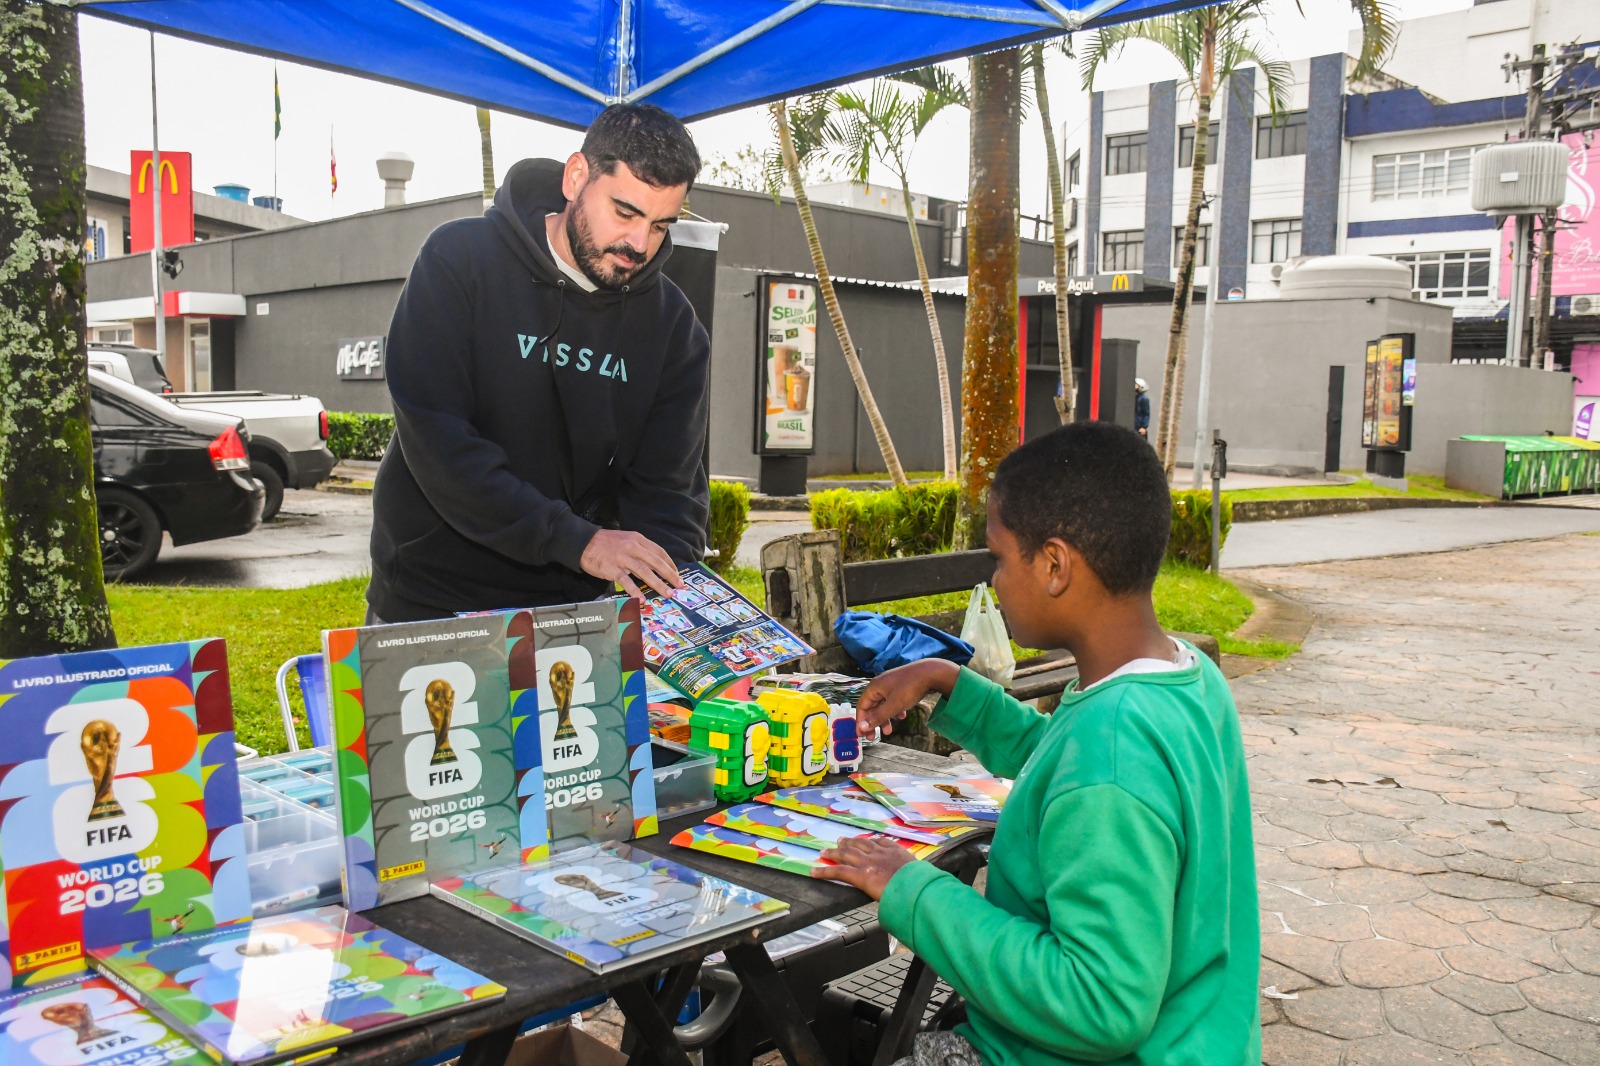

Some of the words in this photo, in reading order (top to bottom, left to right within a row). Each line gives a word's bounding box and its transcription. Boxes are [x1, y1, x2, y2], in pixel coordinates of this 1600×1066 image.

[1067, 277, 1094, 293] Aqui
[517, 333, 628, 383] VISSLA
[533, 618, 575, 629] ILUSTRADO
[575, 615, 604, 624] OFICIAL
[378, 638, 406, 648] LIVRO
[406, 632, 456, 645] ILUSTRADO
[456, 629, 490, 639] OFICIAL
[13, 676, 54, 689] LIVRO
[55, 668, 127, 684] ILUSTRADO
[127, 663, 174, 676] OFICIAL
[553, 744, 583, 761] FIFA
[428, 769, 463, 787] FIFA
[578, 768, 602, 783] CUP
[544, 782, 604, 811] 2026
[408, 801, 458, 821] WORLD
[459, 795, 486, 810] CUP
[86, 824, 133, 847] FIFA
[409, 809, 487, 843] 2026
[57, 863, 126, 889] WORLD
[127, 855, 163, 874] CUP
[392, 862, 424, 875] PANINI
[58, 872, 165, 916] 2026
[604, 895, 641, 907] FIFA
[603, 905, 652, 921] WORLD
[652, 897, 677, 908] CUP
[615, 902, 692, 928] 2026
[35, 943, 78, 960] PANINI
[329, 981, 384, 1000] 26
[335, 975, 369, 987] CUP
[80, 1035, 139, 1055] FIFA
[143, 1038, 185, 1055] CUP
[124, 1045, 199, 1066] 26
